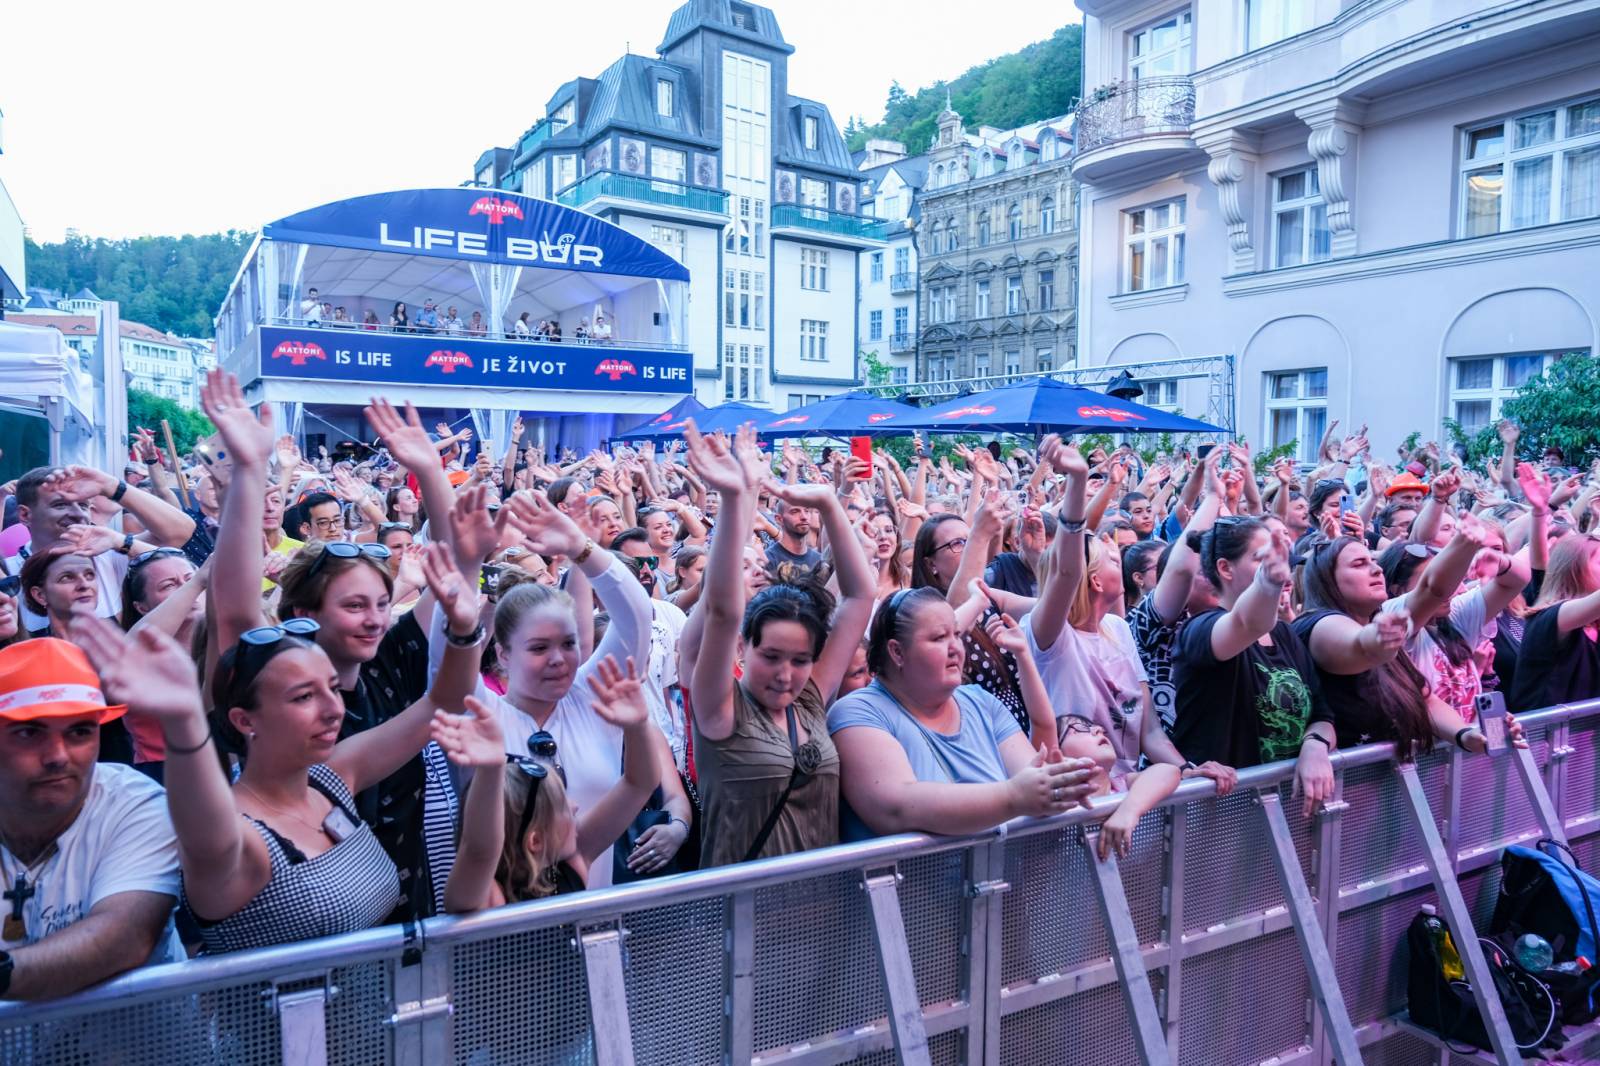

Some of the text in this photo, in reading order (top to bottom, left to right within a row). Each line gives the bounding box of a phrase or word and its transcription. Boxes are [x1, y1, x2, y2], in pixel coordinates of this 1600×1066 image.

[475, 203, 518, 215] MATTONI
[380, 223, 488, 256] LIFE
[278, 346, 321, 355] MATTONI
[335, 350, 392, 367] IS LIFE
[431, 355, 468, 364] MATTONI
[482, 355, 567, 375] JE ŽIVOT
[599, 364, 633, 372] MATTONI
[643, 366, 686, 380] IS LIFE
